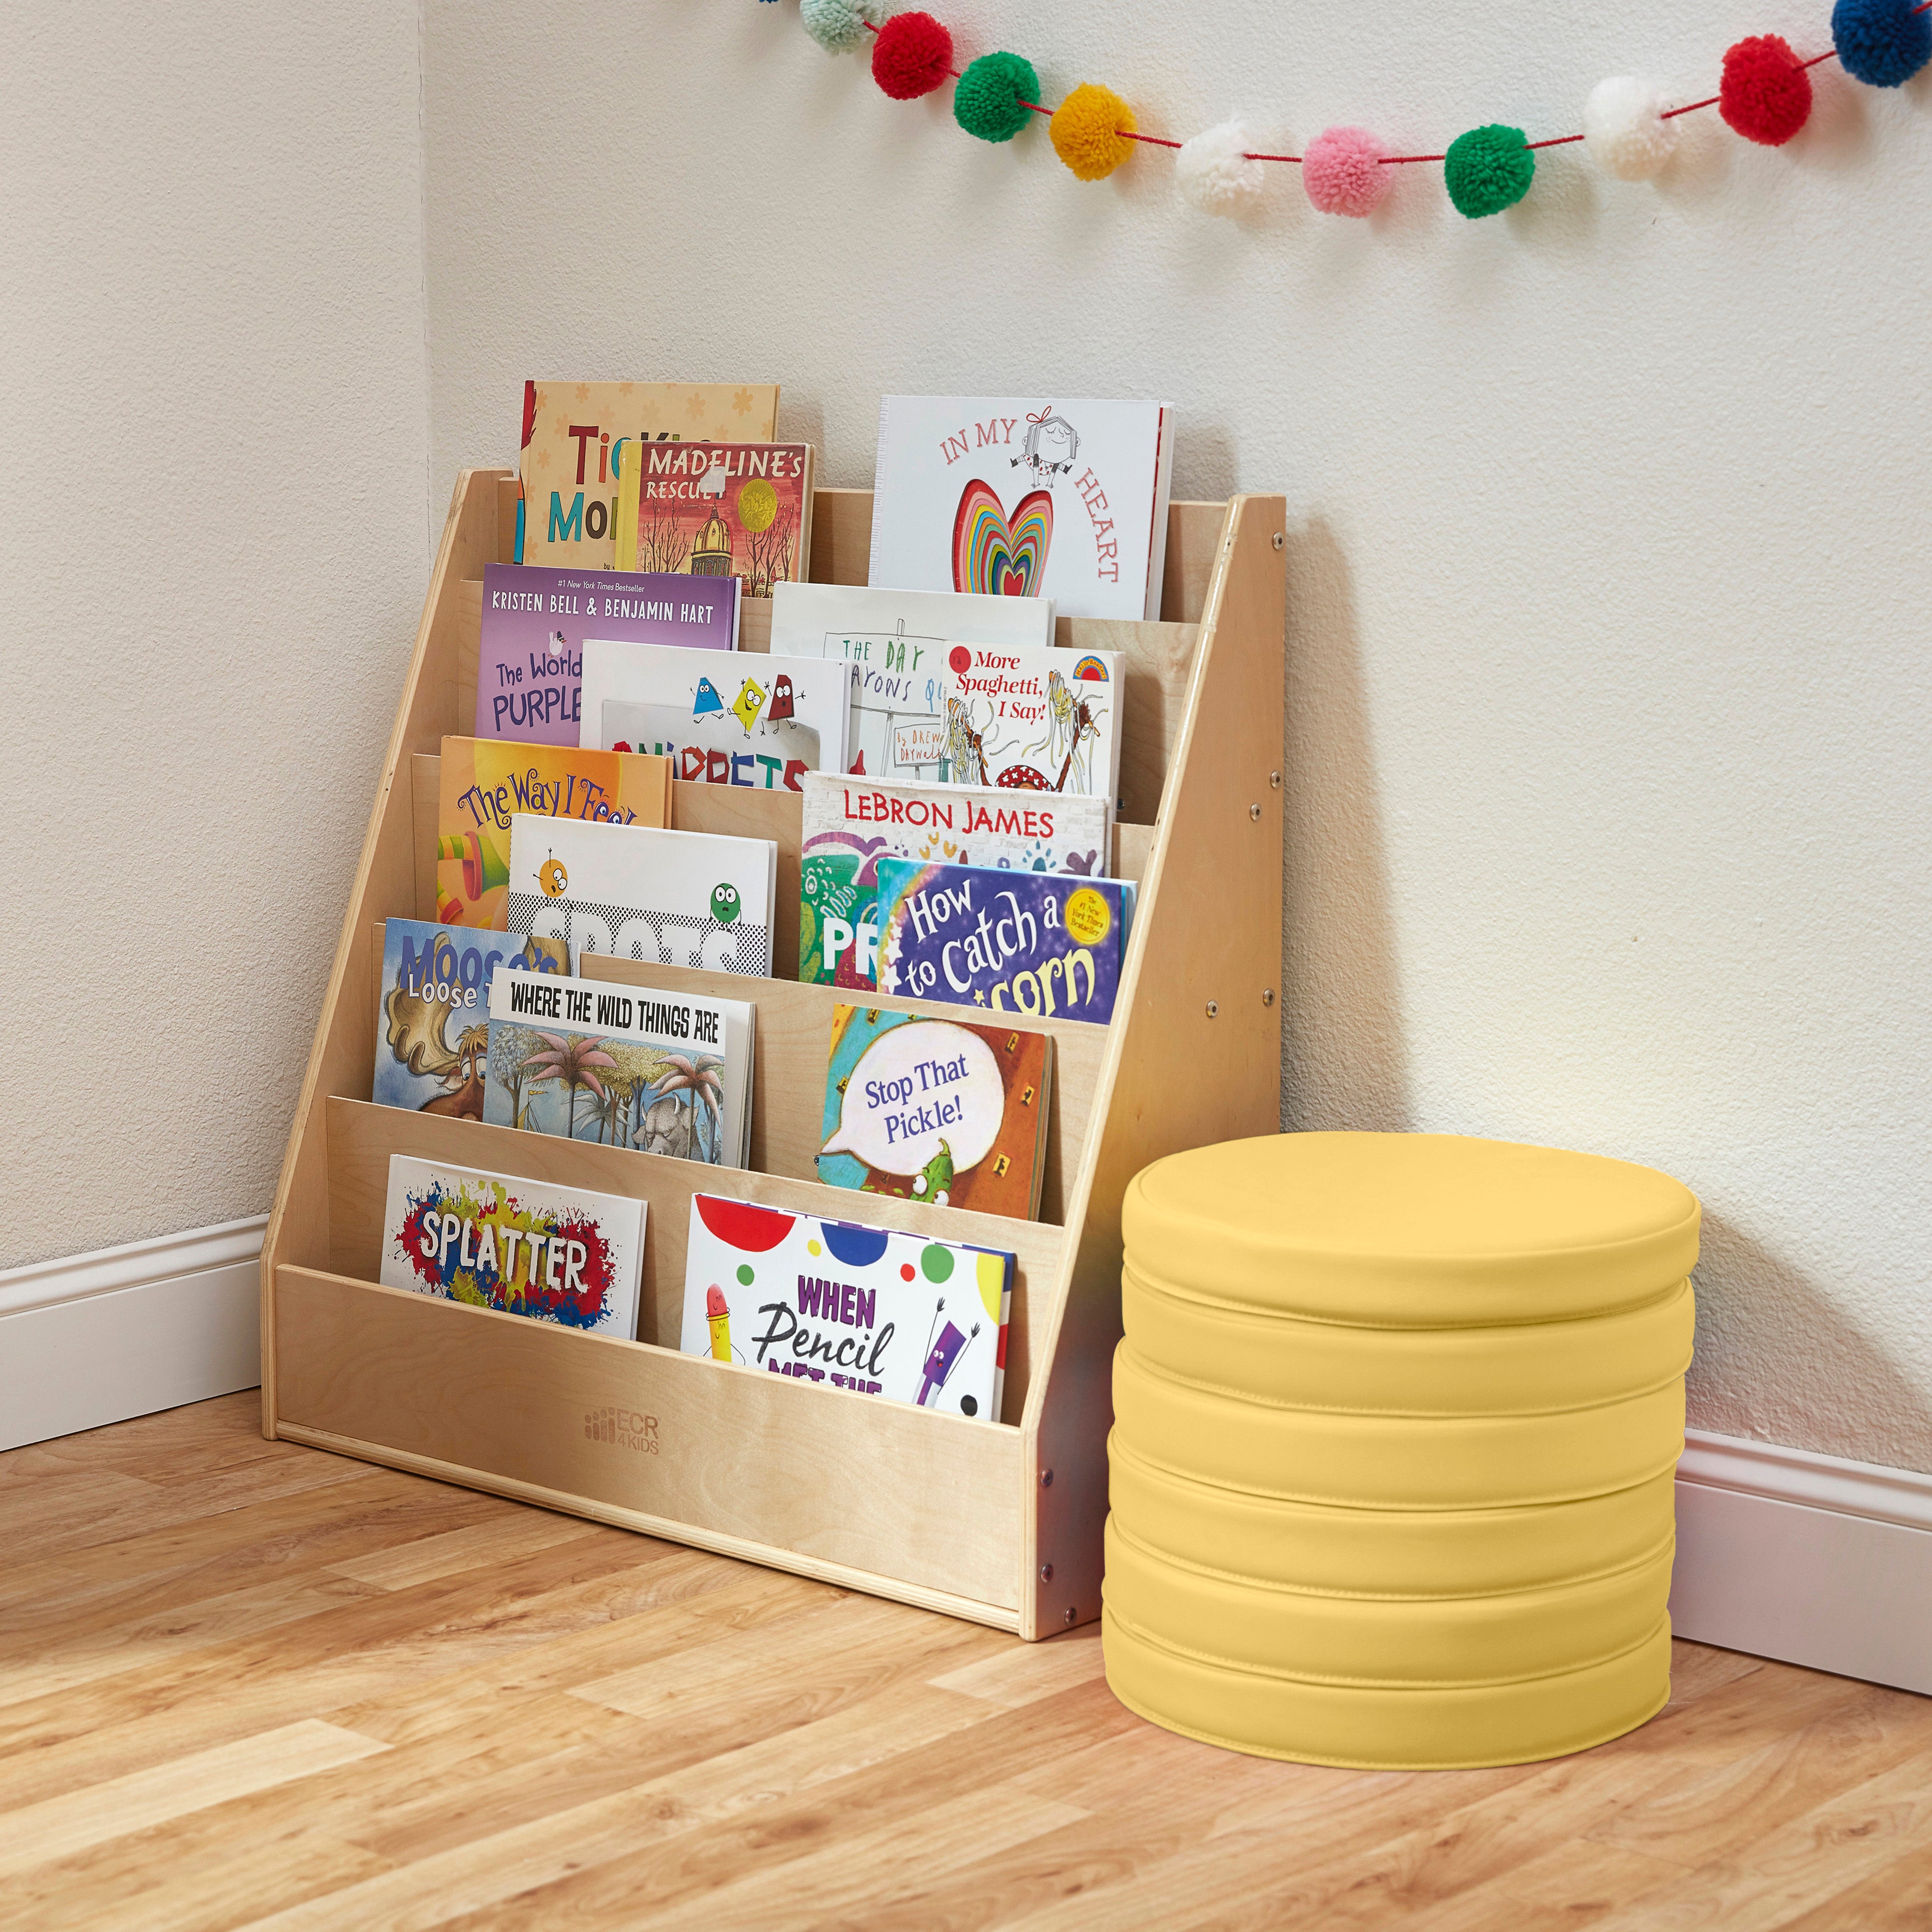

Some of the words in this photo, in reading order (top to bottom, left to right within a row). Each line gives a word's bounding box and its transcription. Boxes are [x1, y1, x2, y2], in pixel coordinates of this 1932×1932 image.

[939, 429, 968, 465] IN
[975, 418, 1017, 447] MY
[646, 481, 712, 499] RESCU
[1074, 468, 1118, 582] HEART
[567, 580, 581, 588] New
[583, 581, 595, 589] York
[597, 582, 614, 591] Times
[615, 583, 645, 593] Bestseller
[492, 591, 542, 612] KRISTEN
[550, 595, 579, 615] BELL
[586, 597, 597, 616] &
[605, 598, 673, 622] BENJAMIN
[681, 604, 713, 624] HART
[496, 663, 522, 687] The
[530, 650, 582, 679] World
[843, 640, 871, 661] THE
[885, 641, 924, 673] DAY
[974, 651, 1020, 670] More
[851, 664, 911, 701] AYONS
[956, 673, 1043, 698] Spaghetti,
[998, 701, 1007, 717] I
[1010, 701, 1046, 725] Say!
[912, 729, 940, 744] DREW
[457, 784, 512, 830] The
[507, 768, 561, 816] Way
[563, 773, 577, 815] I
[962, 801, 1054, 838] JAMES
[904, 879, 971, 943] How
[905, 960, 937, 996] to
[942, 891, 1037, 993] Catch
[1044, 895, 1061, 929] a
[409, 973, 478, 1009] Loose
[991, 948, 1095, 1017] corn
[511, 981, 561, 1019] WHERE
[565, 989, 592, 1023] THE
[597, 994, 632, 1029] WILD
[639, 1001, 689, 1039] THINGS
[694, 1009, 720, 1044] ARE
[865, 1075, 913, 1109] Stop
[914, 1053, 969, 1092] That
[884, 1094, 963, 1145] Pickle!
[420, 1211, 588, 1294] SPLATTER
[797, 1275, 877, 1329] WHEN
[751, 1302, 895, 1377] Pencil
[617, 1409, 659, 1440] ECR
